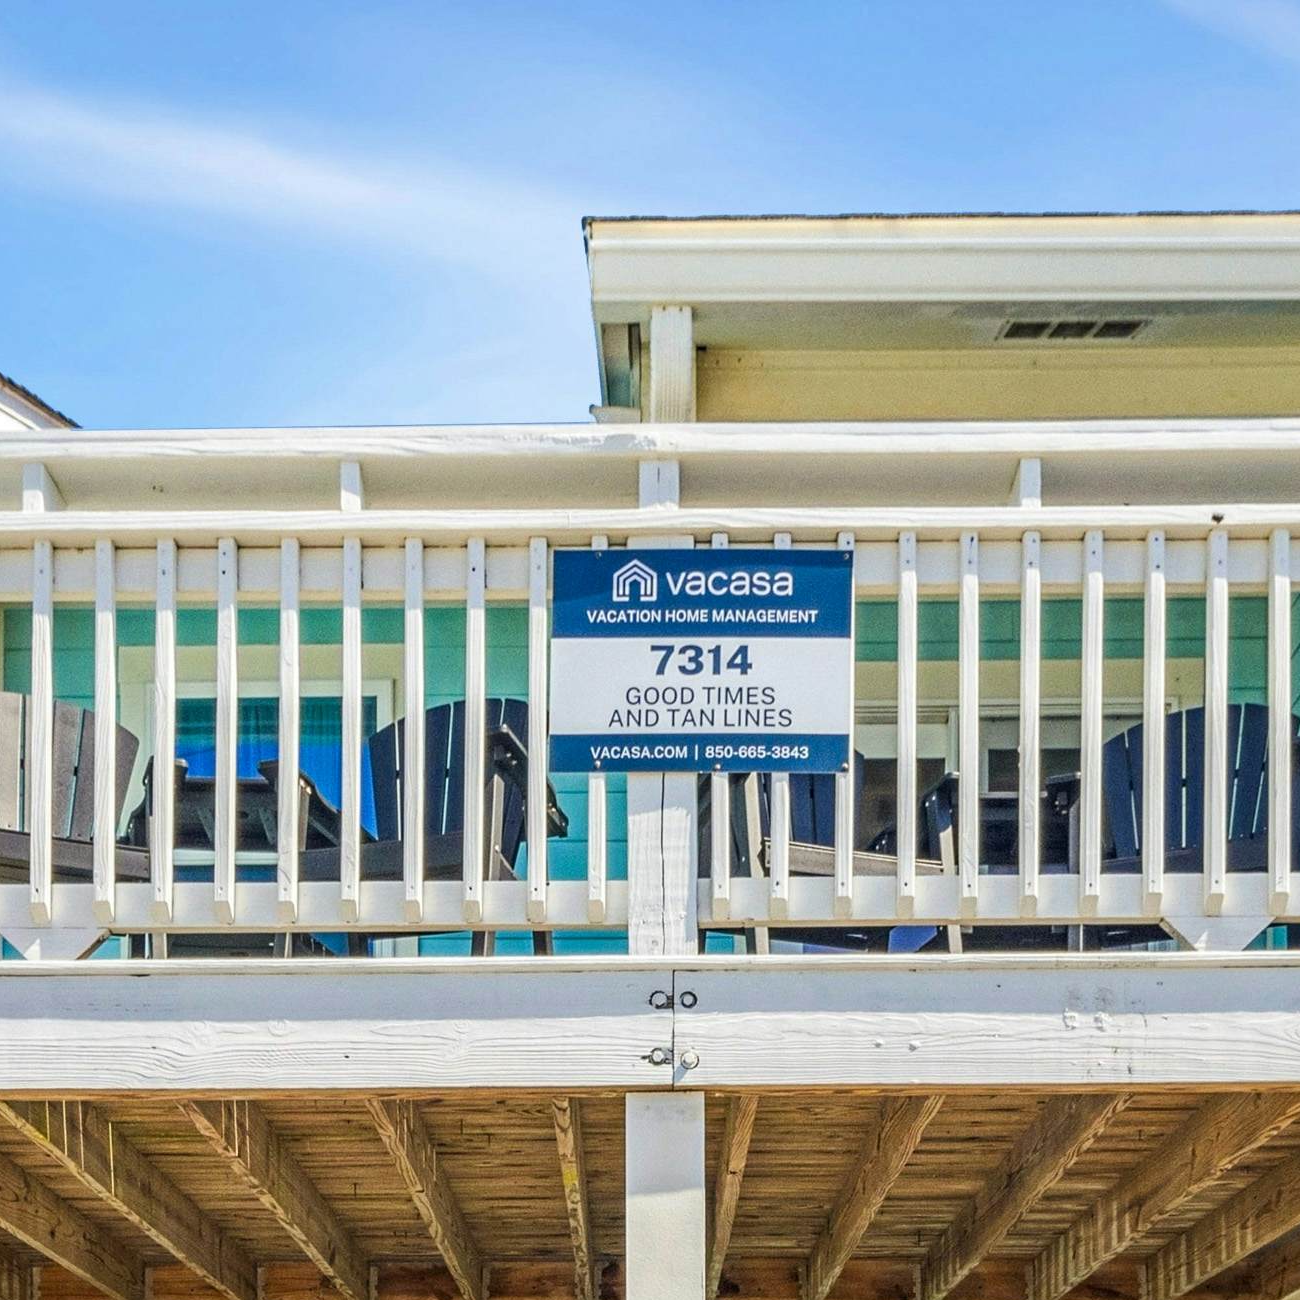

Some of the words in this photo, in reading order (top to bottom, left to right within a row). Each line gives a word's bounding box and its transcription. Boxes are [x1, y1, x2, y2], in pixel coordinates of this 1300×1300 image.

[666, 570, 794, 597] vacasa
[586, 609, 662, 624] VACATION
[665, 609, 709, 624] HOME
[712, 609, 818, 624] MANAGEMENT
[650, 644, 753, 676] 7314
[625, 686, 695, 705] GOOD
[702, 686, 776, 705] TIMES
[608, 708, 660, 728] AND
[667, 708, 715, 728] TAN
[723, 708, 793, 728] LINES
[590, 746, 688, 760] VACASA.COM
[704, 745, 809, 760] 850-665-3843
